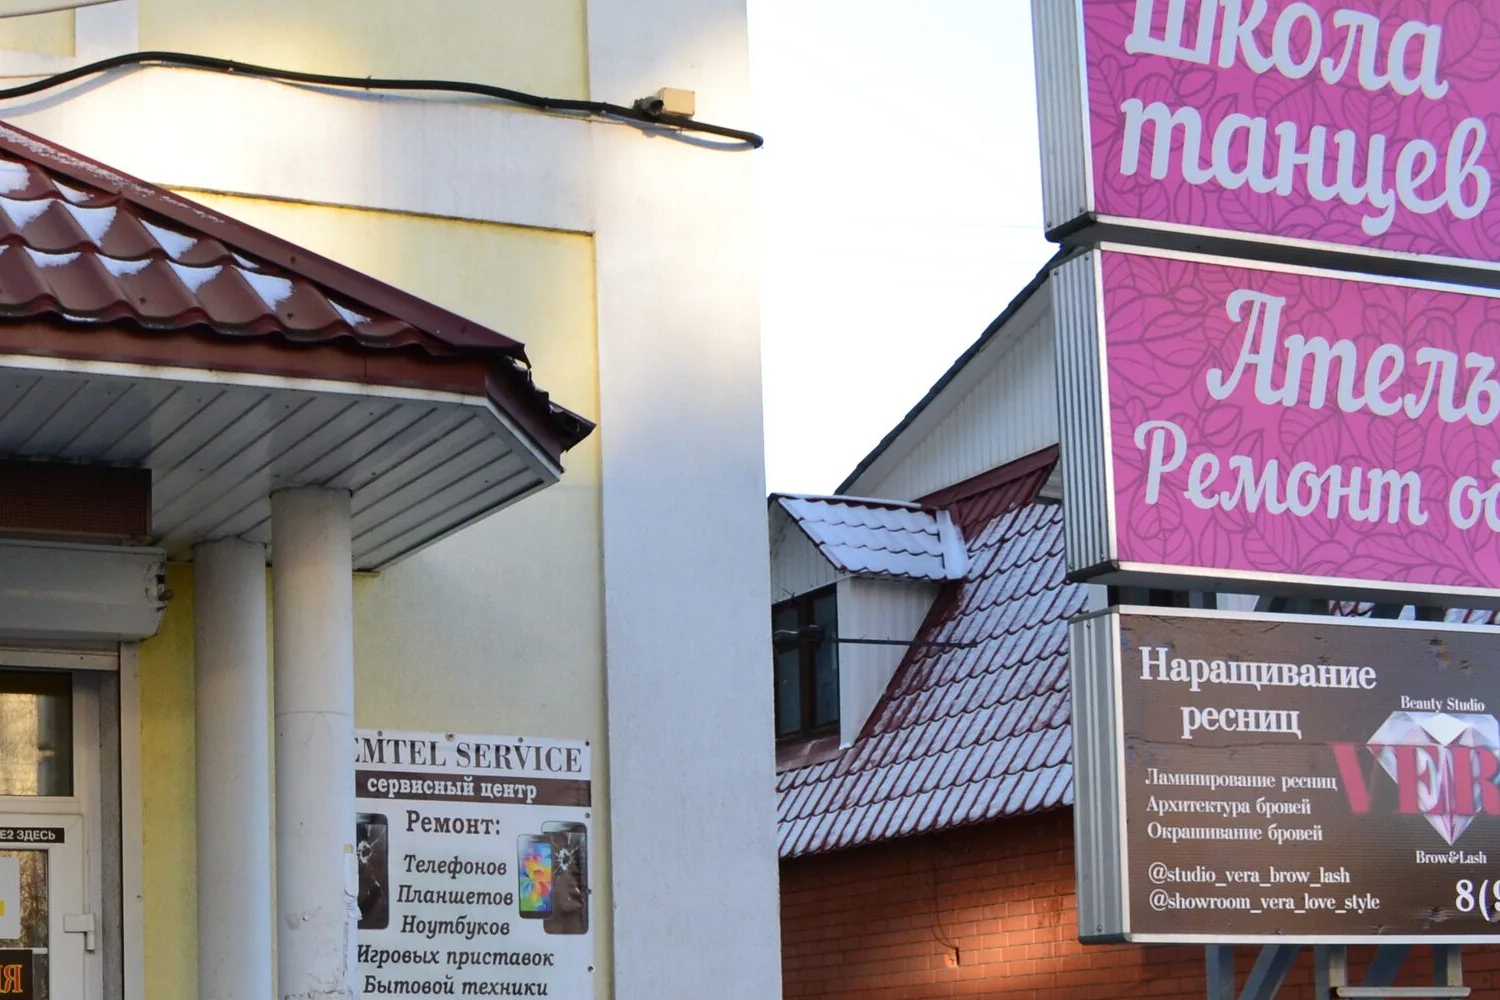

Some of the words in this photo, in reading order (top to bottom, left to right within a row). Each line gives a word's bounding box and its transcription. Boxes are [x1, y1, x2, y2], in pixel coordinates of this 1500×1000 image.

[1120, 98, 1491, 236] танцев
[1134, 420, 1428, 526] Ремонт
[1138, 647, 1377, 692] Наращивание
[1400, 695, 1442, 713] Beauty
[1446, 697, 1485, 712] Studio
[1180, 705, 1302, 739] ресниц
[456, 743, 582, 773] SERVICE
[367, 776, 474, 797] сервисный
[480, 783, 537, 803] центр
[1145, 768, 1275, 790] Ламинирование
[1281, 775, 1337, 792] ресниц
[1146, 796, 1250, 817] Архитектура
[1256, 797, 1311, 818] бровей
[406, 810, 500, 835] Ремонт:
[1147, 822, 1262, 843] Окрашивание
[1267, 824, 1322, 844] бровей
[16, 830, 56, 841] ЗДЕСЬ
[404, 855, 507, 879] Телефонов
[1416, 850, 1487, 864] Brow&Lash
[1149, 862, 1350, 887] @studio_vera_brow_lash
[397, 885, 513, 906] Планшетов
[1149, 888, 1380, 913] @showroom_vera_love_style
[401, 915, 510, 940] Ноутбуков
[358, 944, 439, 968] Игровых
[446, 950, 554, 969] приставок
[363, 974, 454, 995] Бытовой
[462, 980, 548, 996] техники
